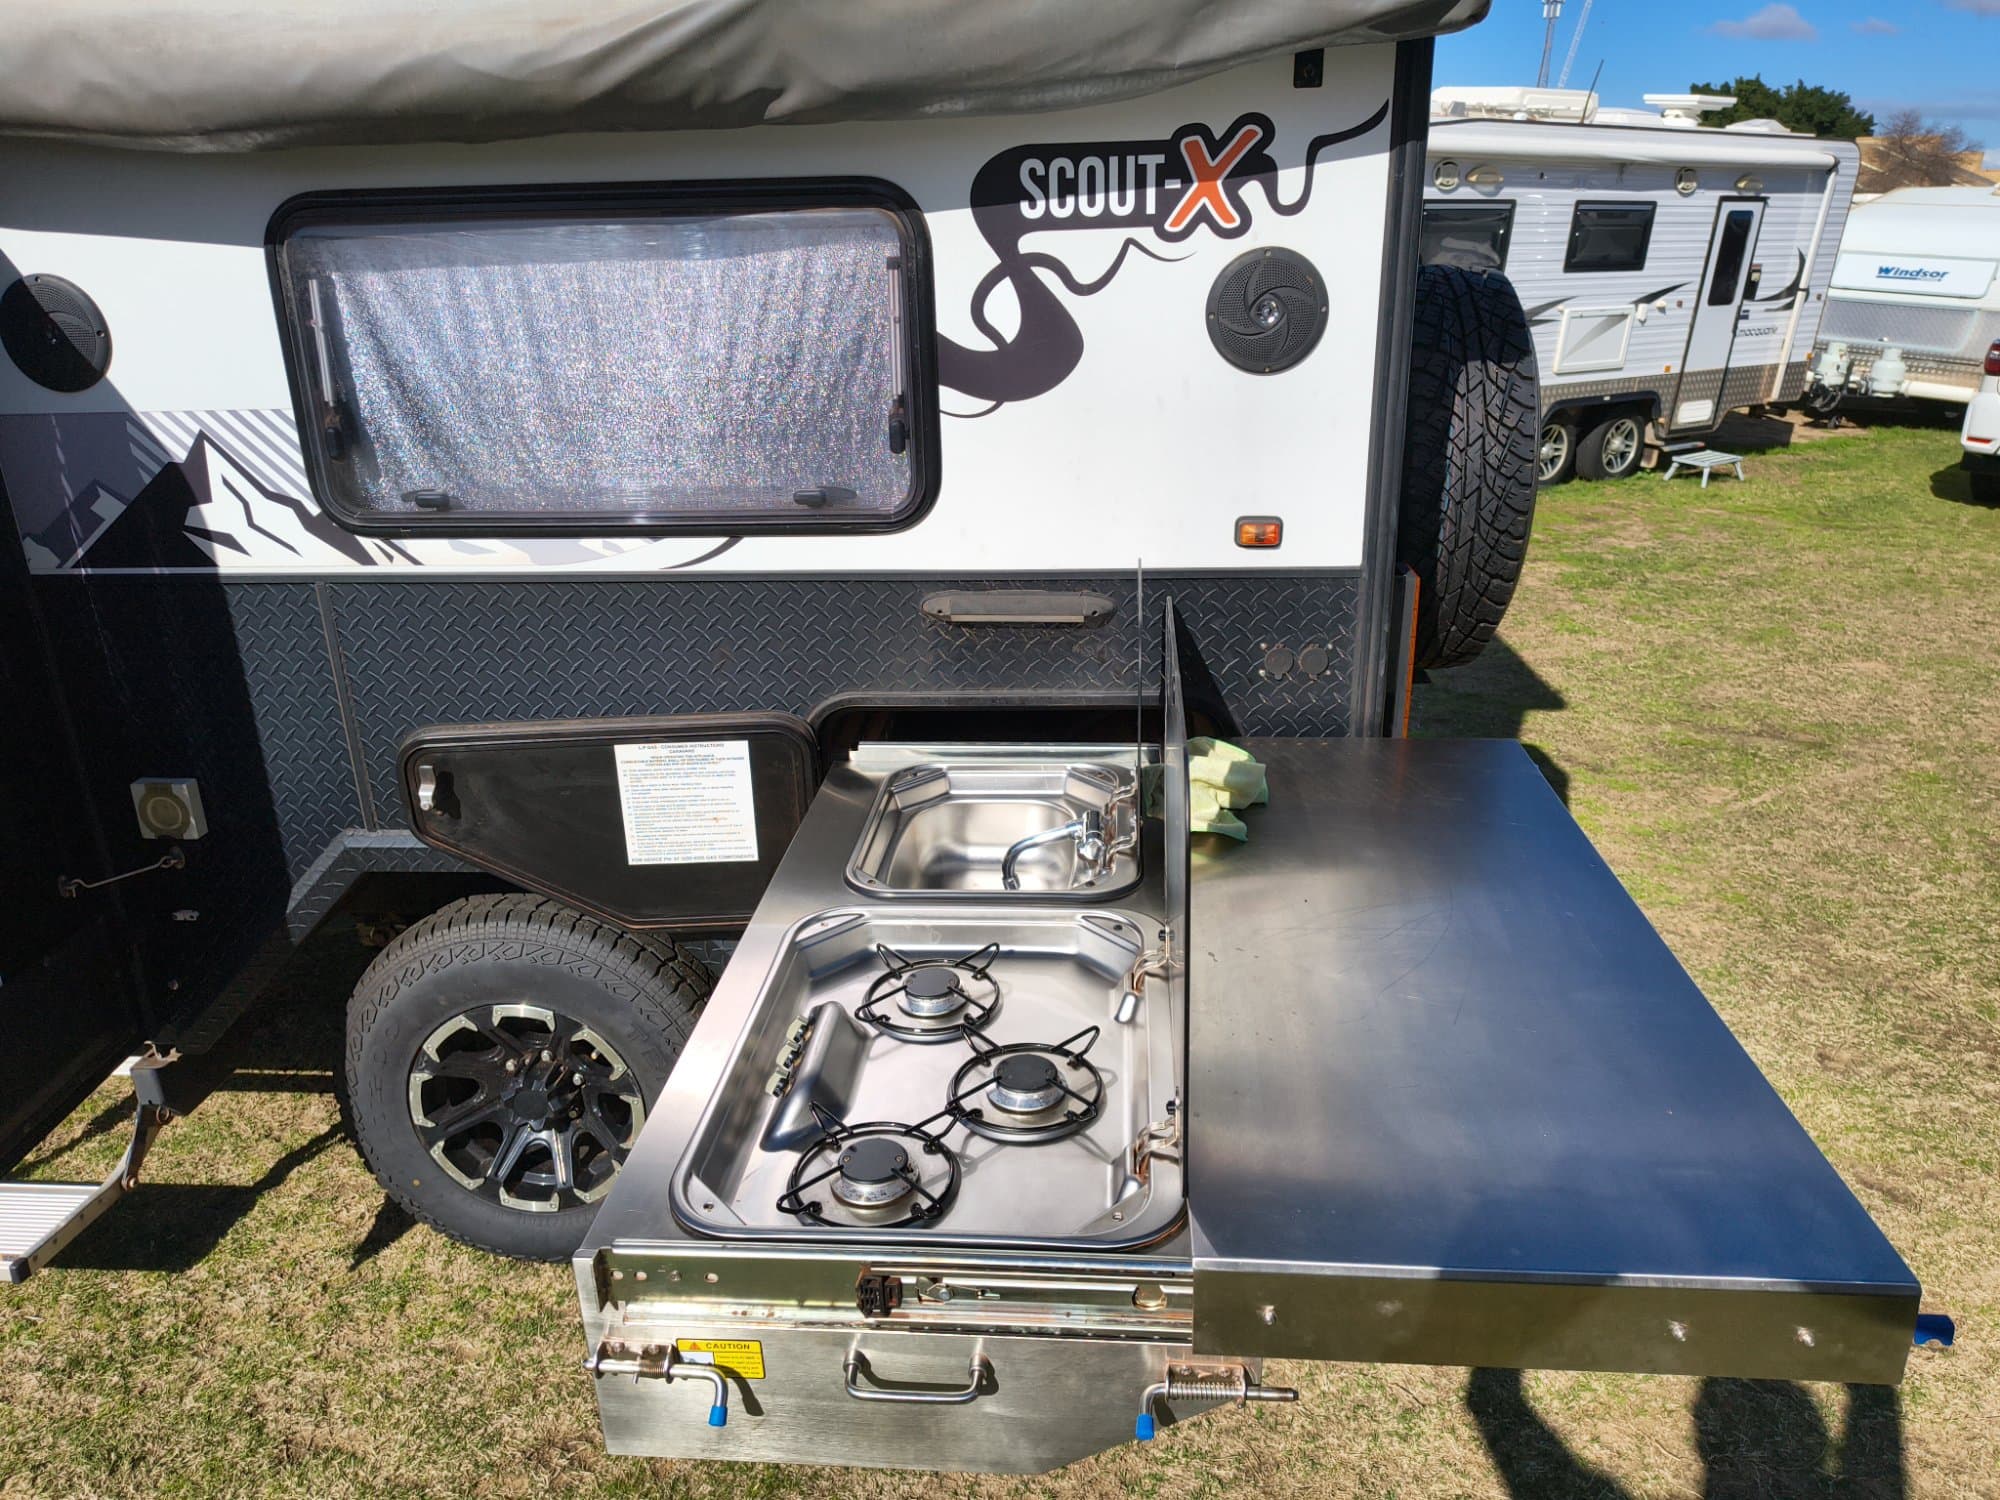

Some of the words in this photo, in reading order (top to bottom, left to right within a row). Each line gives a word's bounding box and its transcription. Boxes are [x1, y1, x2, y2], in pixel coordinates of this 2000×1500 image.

[1019, 123, 1263, 232] SCOUT-X
[1876, 266, 1950, 280] Windsor
[706, 1342, 750, 1350] CAUTION
